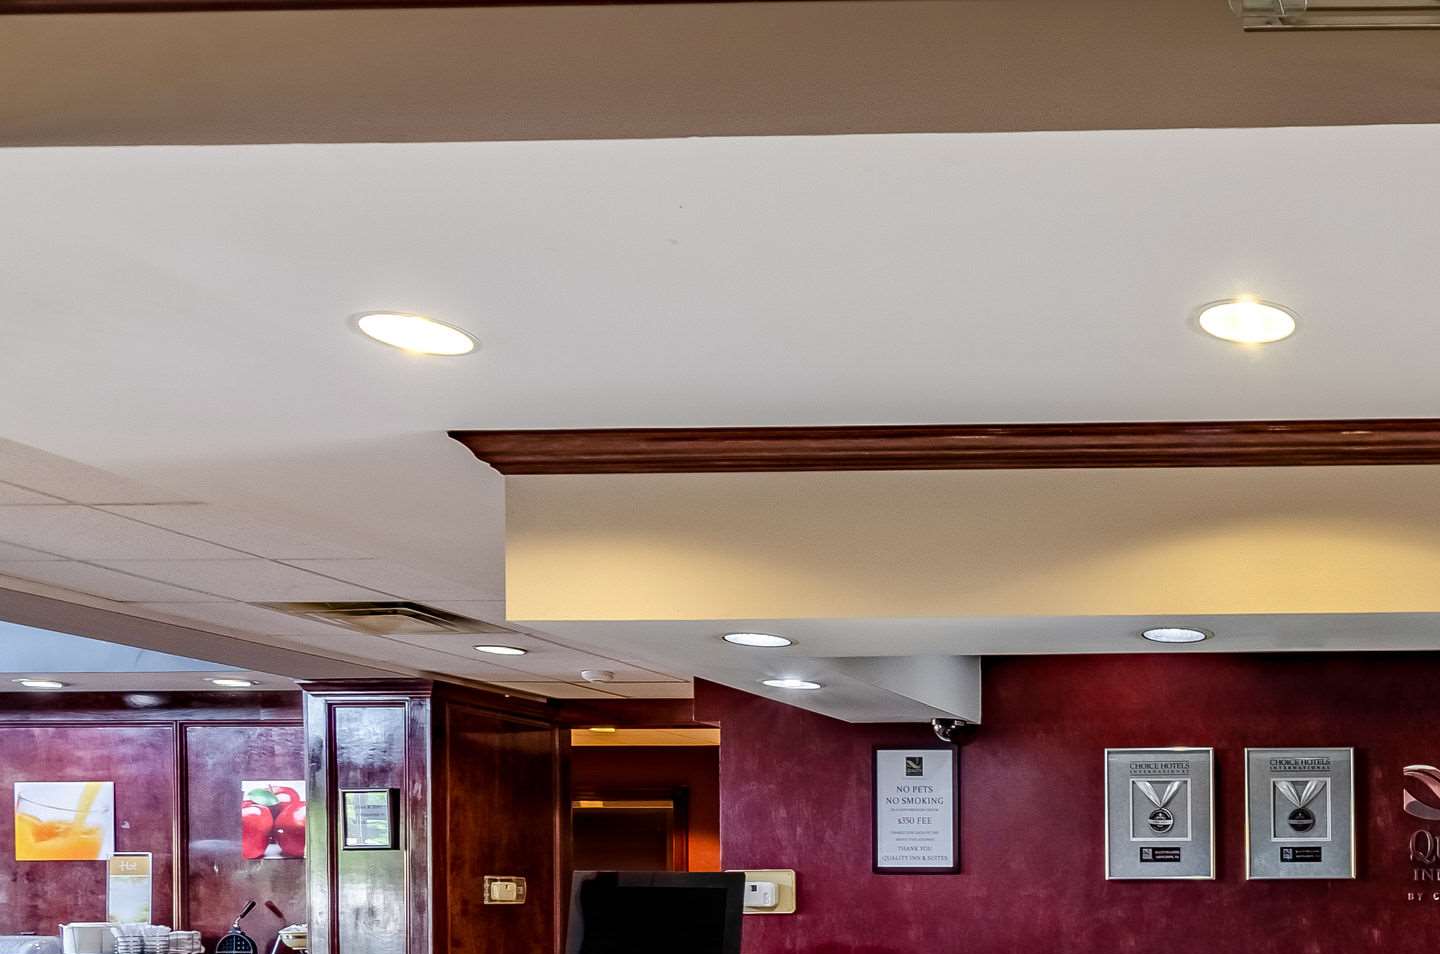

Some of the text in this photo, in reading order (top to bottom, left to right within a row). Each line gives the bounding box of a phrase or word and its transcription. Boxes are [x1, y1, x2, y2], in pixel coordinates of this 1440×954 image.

[896, 785, 934, 793] NO PETS
[886, 797, 944, 805] NO SMOKING
[917, 816, 932, 825] FEE
[1407, 892, 1423, 901] BY
